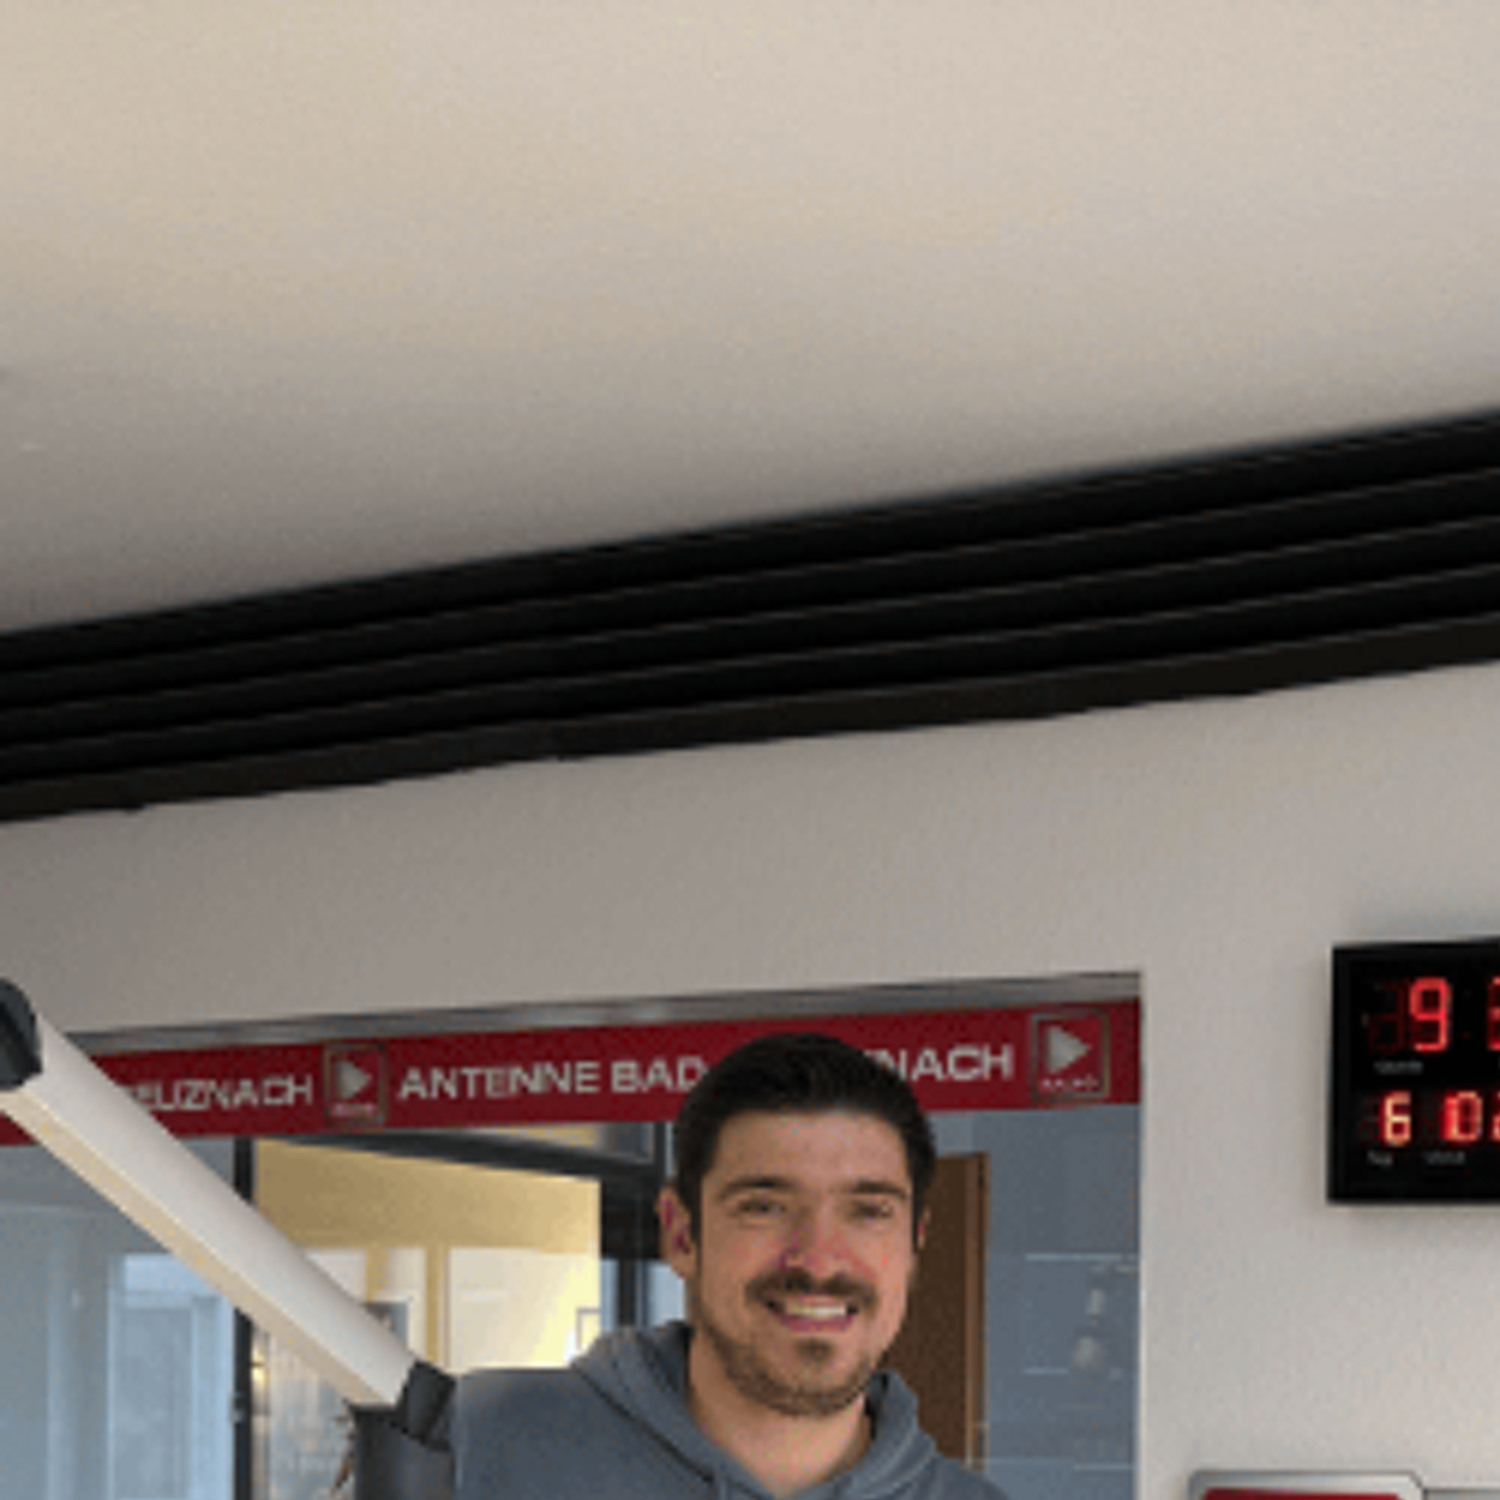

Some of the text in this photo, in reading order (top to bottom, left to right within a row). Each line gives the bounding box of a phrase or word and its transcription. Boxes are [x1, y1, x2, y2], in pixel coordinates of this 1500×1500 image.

[1409, 977, 1451, 1052] 9
[399, 1060, 600, 1100] ANTENNE
[611, 1056, 708, 1094] BAD
